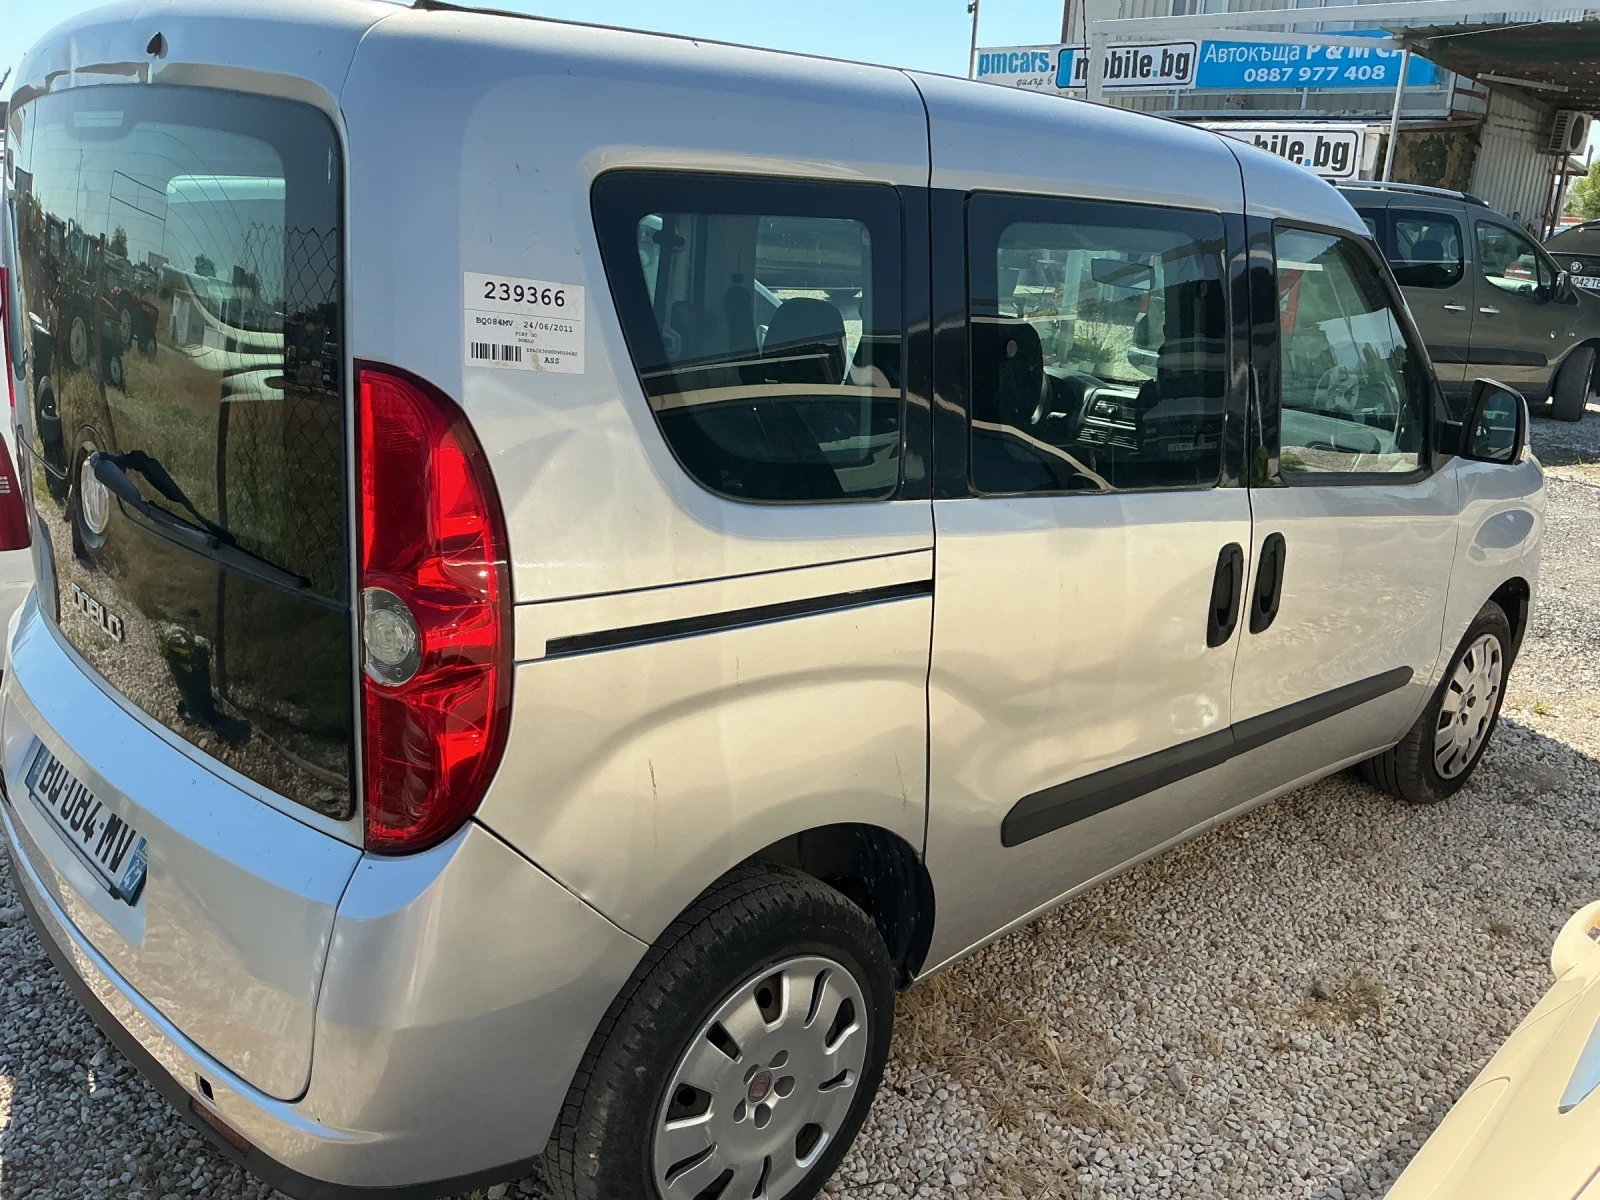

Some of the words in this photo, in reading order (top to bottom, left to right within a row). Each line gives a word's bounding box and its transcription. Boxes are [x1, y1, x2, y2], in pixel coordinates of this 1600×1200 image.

[1203, 43, 1300, 65] Автокъща
[1075, 49, 1190, 80] mbile.bg
[1243, 67, 1293, 83] 0887
[1298, 66, 1339, 82] 977
[1344, 65, 1386, 81] 408
[484, 281, 565, 307] 239366
[475, 316, 514, 327] BQ084MV
[523, 321, 573, 333] 24/06/2011
[543, 356, 560, 365] ASS
